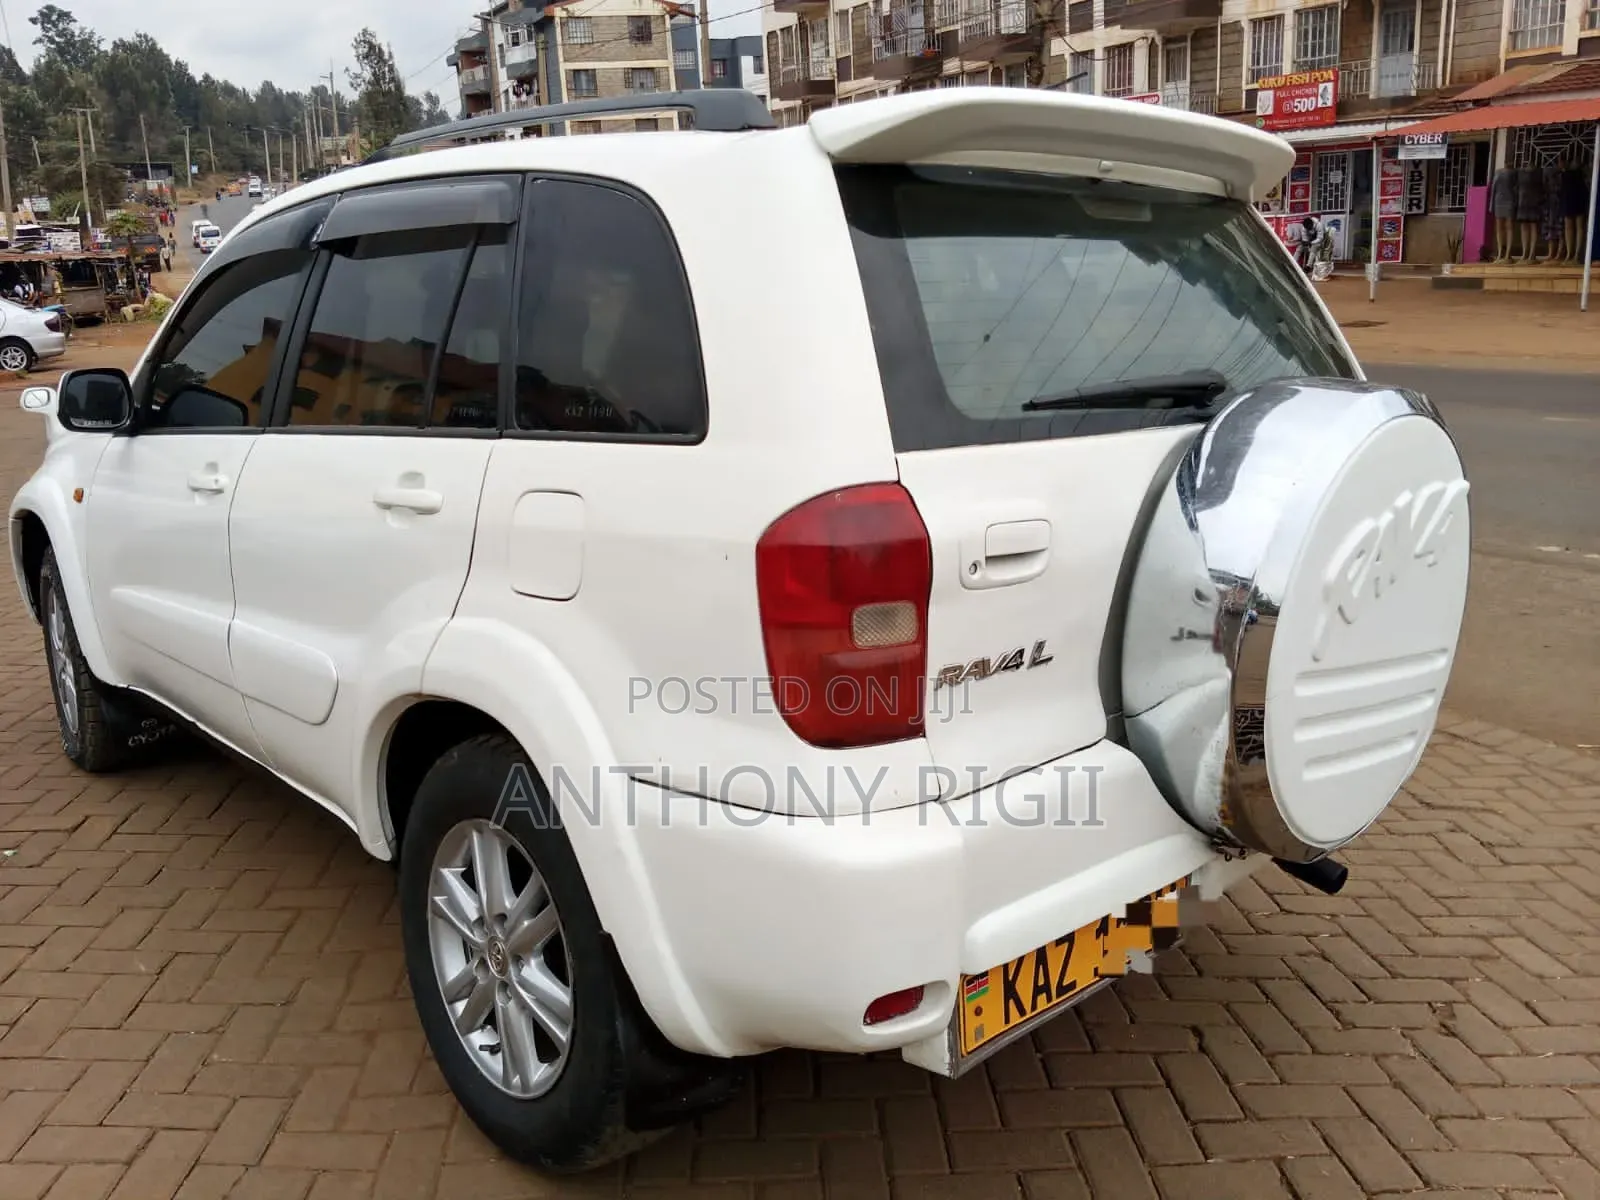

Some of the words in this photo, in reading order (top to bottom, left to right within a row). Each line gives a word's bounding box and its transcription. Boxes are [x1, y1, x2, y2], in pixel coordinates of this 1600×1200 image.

[1258, 76, 1286, 88] KUKU
[1286, 73, 1310, 86] FISH
[1311, 70, 1334, 83] POA
[1291, 88, 1317, 97] CHICKEN
[1405, 134, 1442, 144] CYBER
[934, 647, 1025, 691] RAV4
[1026, 639, 1054, 669] L
[1002, 931, 1077, 1025] KAZ
